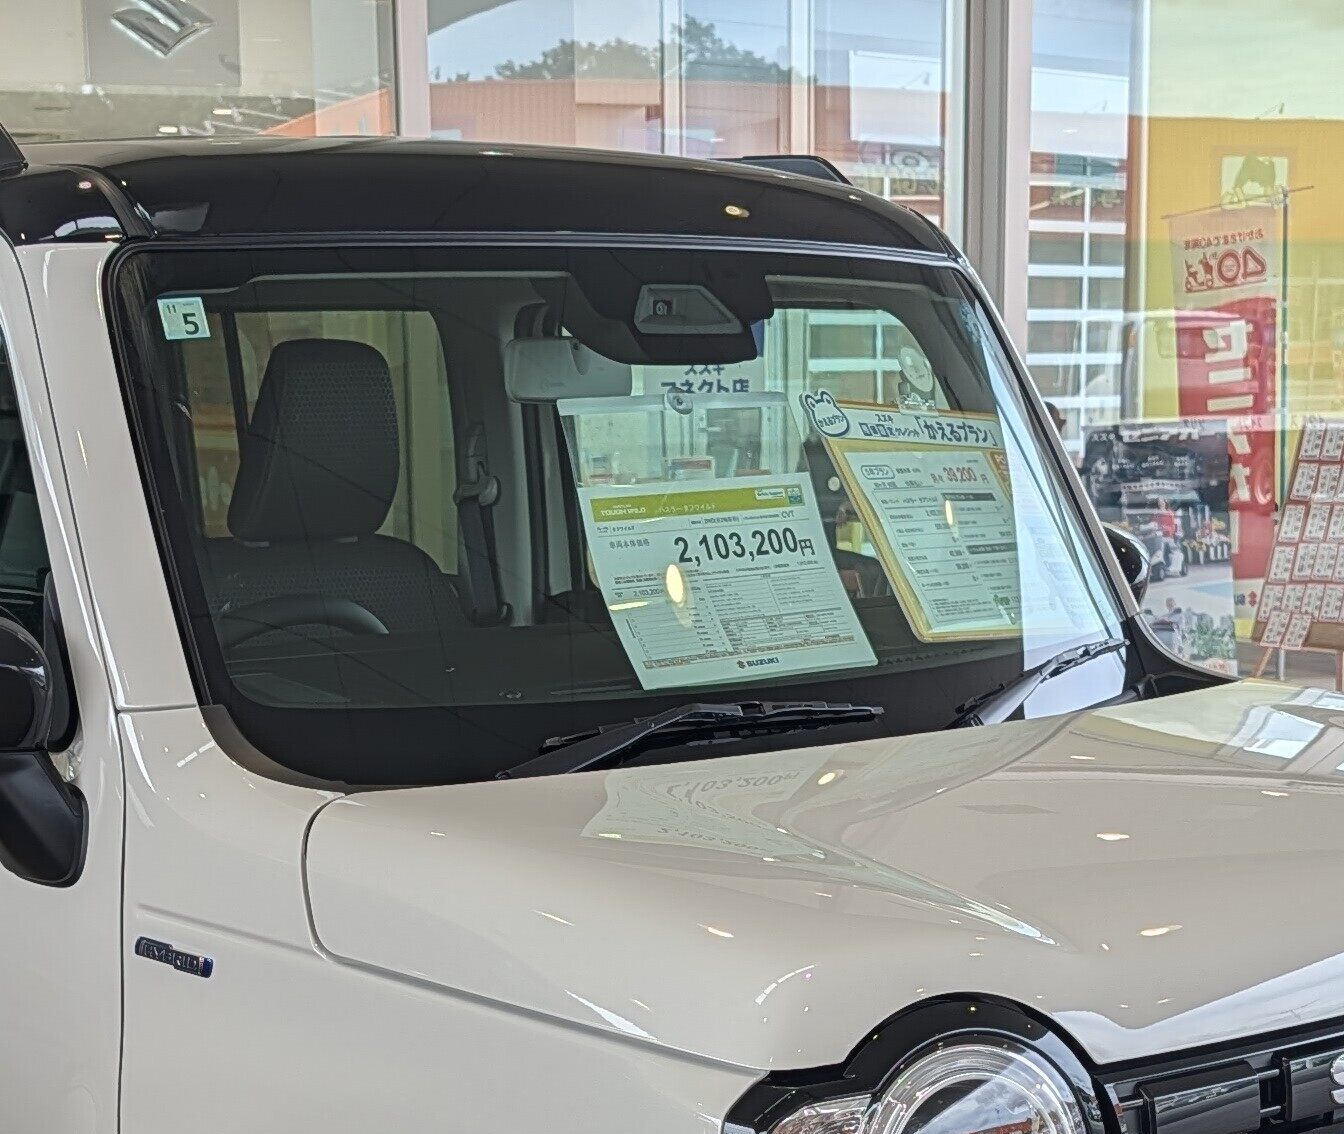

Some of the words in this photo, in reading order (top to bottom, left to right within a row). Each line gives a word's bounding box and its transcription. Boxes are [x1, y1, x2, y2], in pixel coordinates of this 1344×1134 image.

[166, 304, 177, 314] 11
[182, 313, 199, 335] 5
[674, 527, 816, 567] 2,103,200円
[745, 656, 779, 668] SUZUKI
